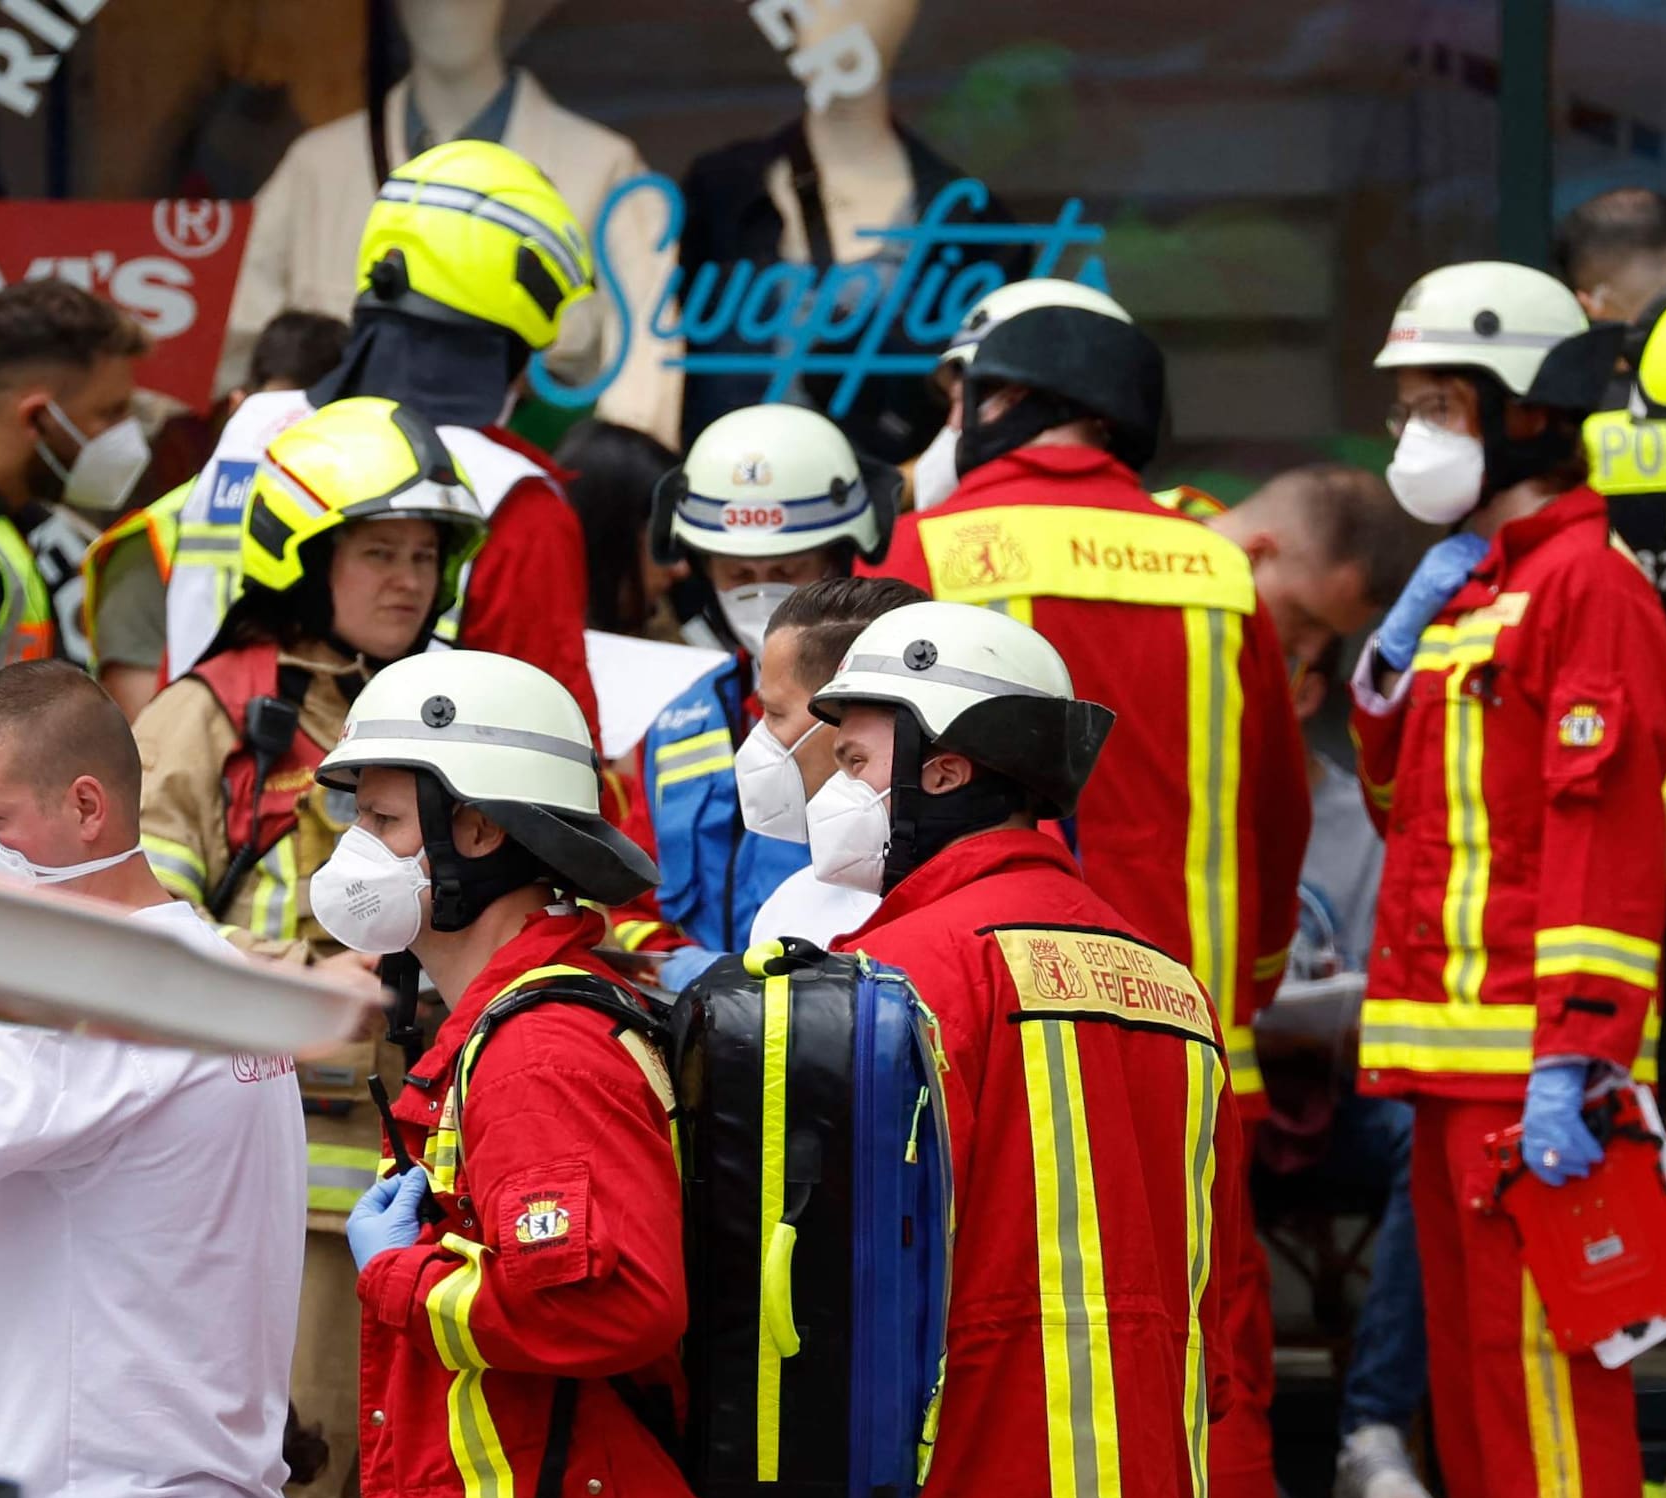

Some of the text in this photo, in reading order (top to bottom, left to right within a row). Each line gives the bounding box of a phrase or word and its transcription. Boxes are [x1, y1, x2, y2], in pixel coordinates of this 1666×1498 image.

[724, 508, 783, 526] 3305
[1070, 537, 1216, 577] Notarzt
[345, 879, 367, 897] MK
[1075, 940, 1159, 977] BERLINER
[1091, 970, 1203, 1026] FEUERWEHR
